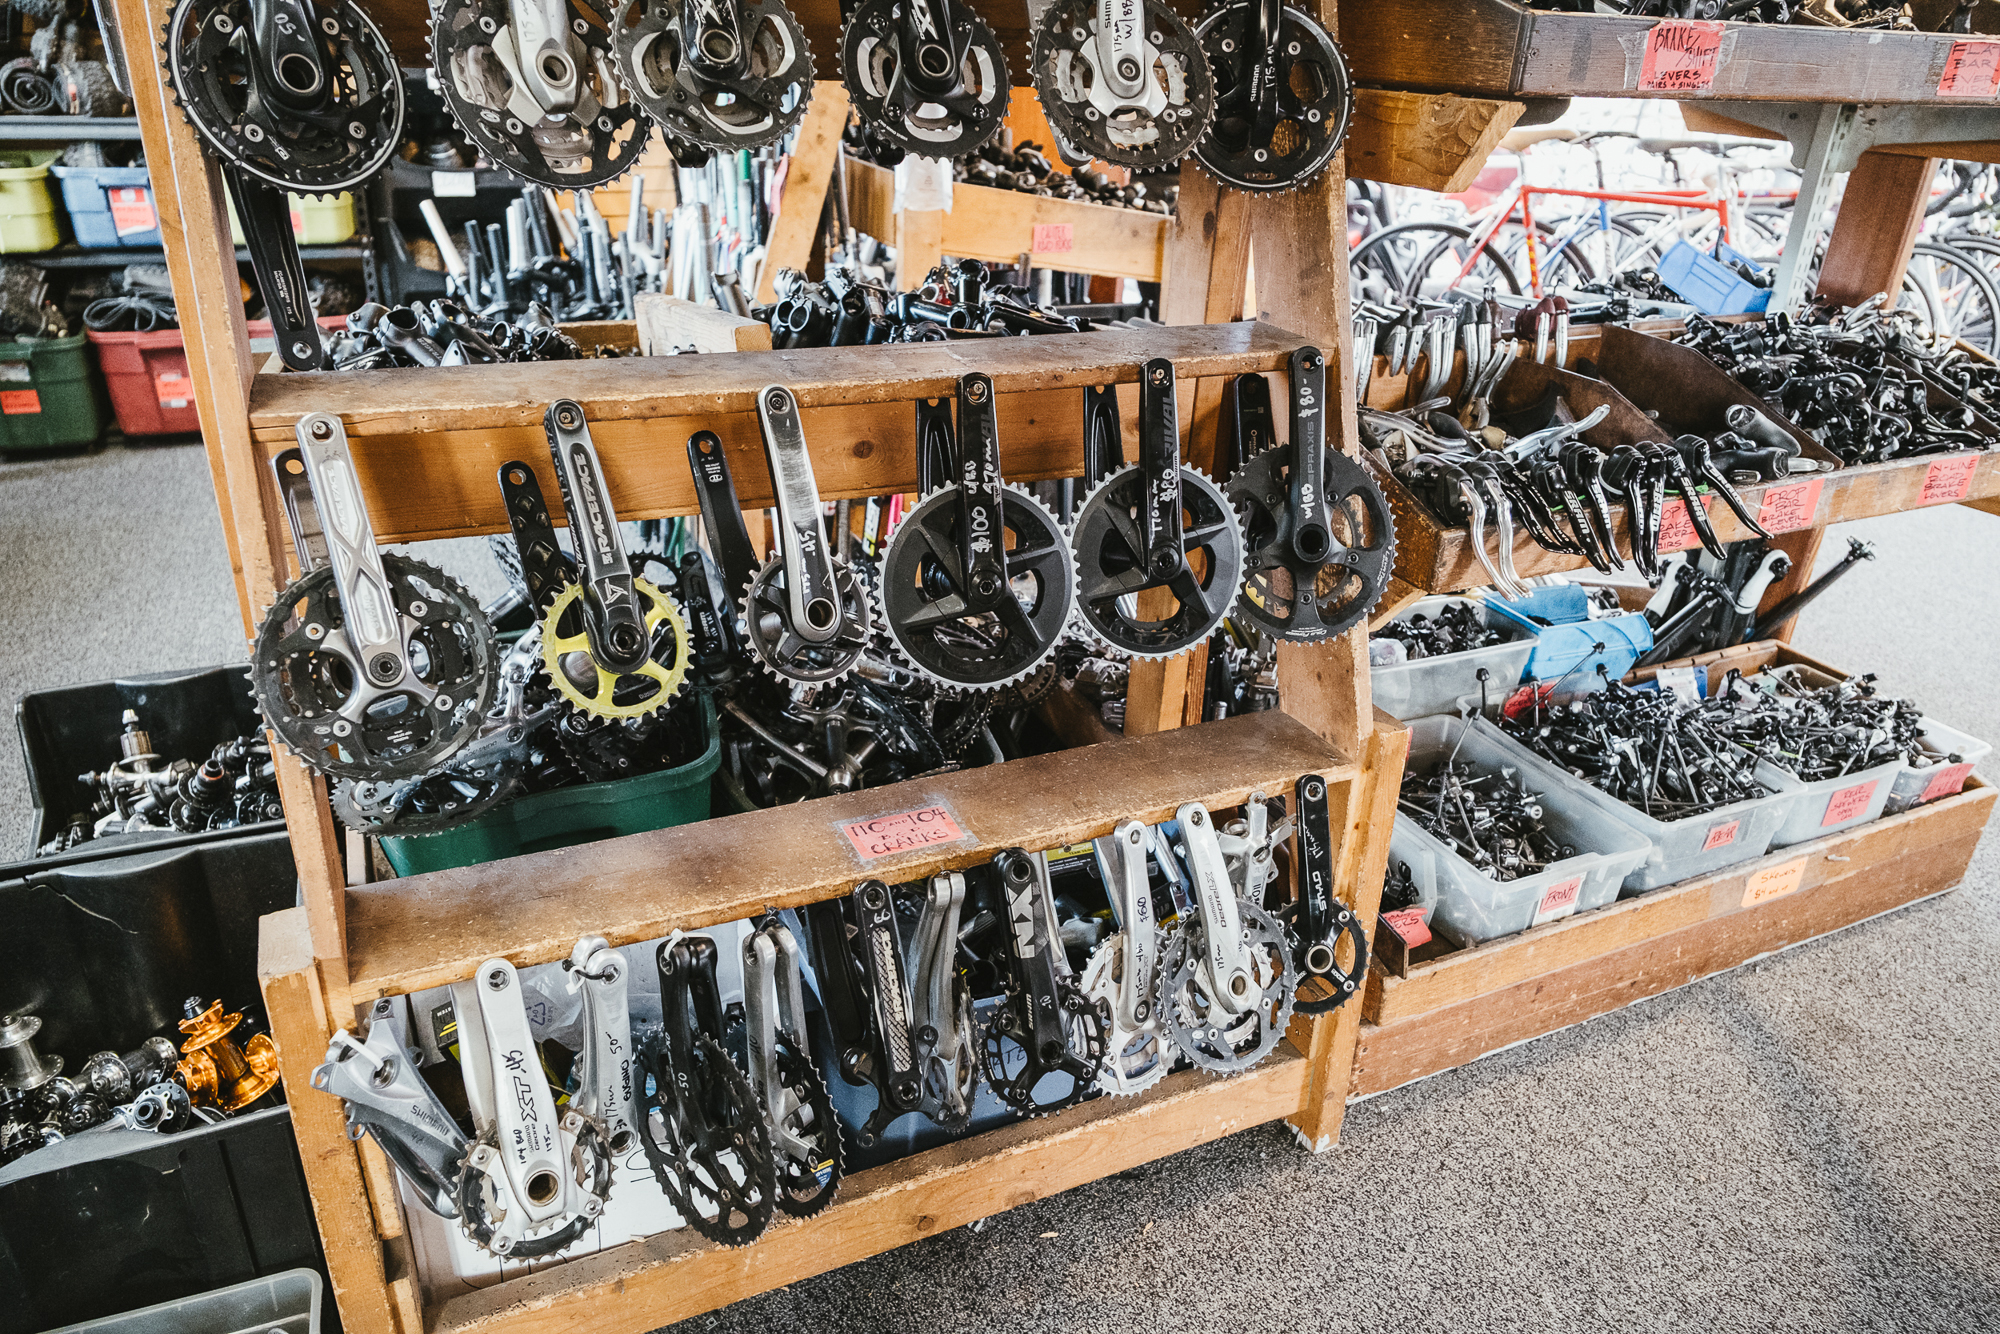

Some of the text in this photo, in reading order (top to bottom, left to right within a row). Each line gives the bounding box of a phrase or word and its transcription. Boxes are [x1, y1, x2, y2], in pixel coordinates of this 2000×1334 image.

[1953, 58, 1999, 72] BAR
[1653, 70, 1702, 81] LEVERS
[1307, 421, 1315, 474] PRAXIS
[1929, 459, 1977, 473] IN-LINE
[1923, 478, 1967, 491] BRAKE
[1923, 488, 1959, 499] LEVERS
[573, 451, 611, 555] RACEFACE
[1680, 476, 1706, 522] SRAM
[1766, 486, 1807, 506] DROP
[1564, 490, 1590, 534] SRAM
[1775, 499, 1805, 512] BAR
[1761, 508, 1800, 524] BRAKE
[1660, 520, 1692, 532] RAKE
[1657, 540, 1682, 550] AIRS
[851, 821, 886, 837] 110
[907, 807, 947, 825] 104
[870, 827, 950, 855] CRANKS
[1761, 869, 1797, 884] Skewers
[1311, 870, 1328, 913] STYLO
[1544, 883, 1579, 905] FRONT
[513, 1075, 538, 1123] XT
